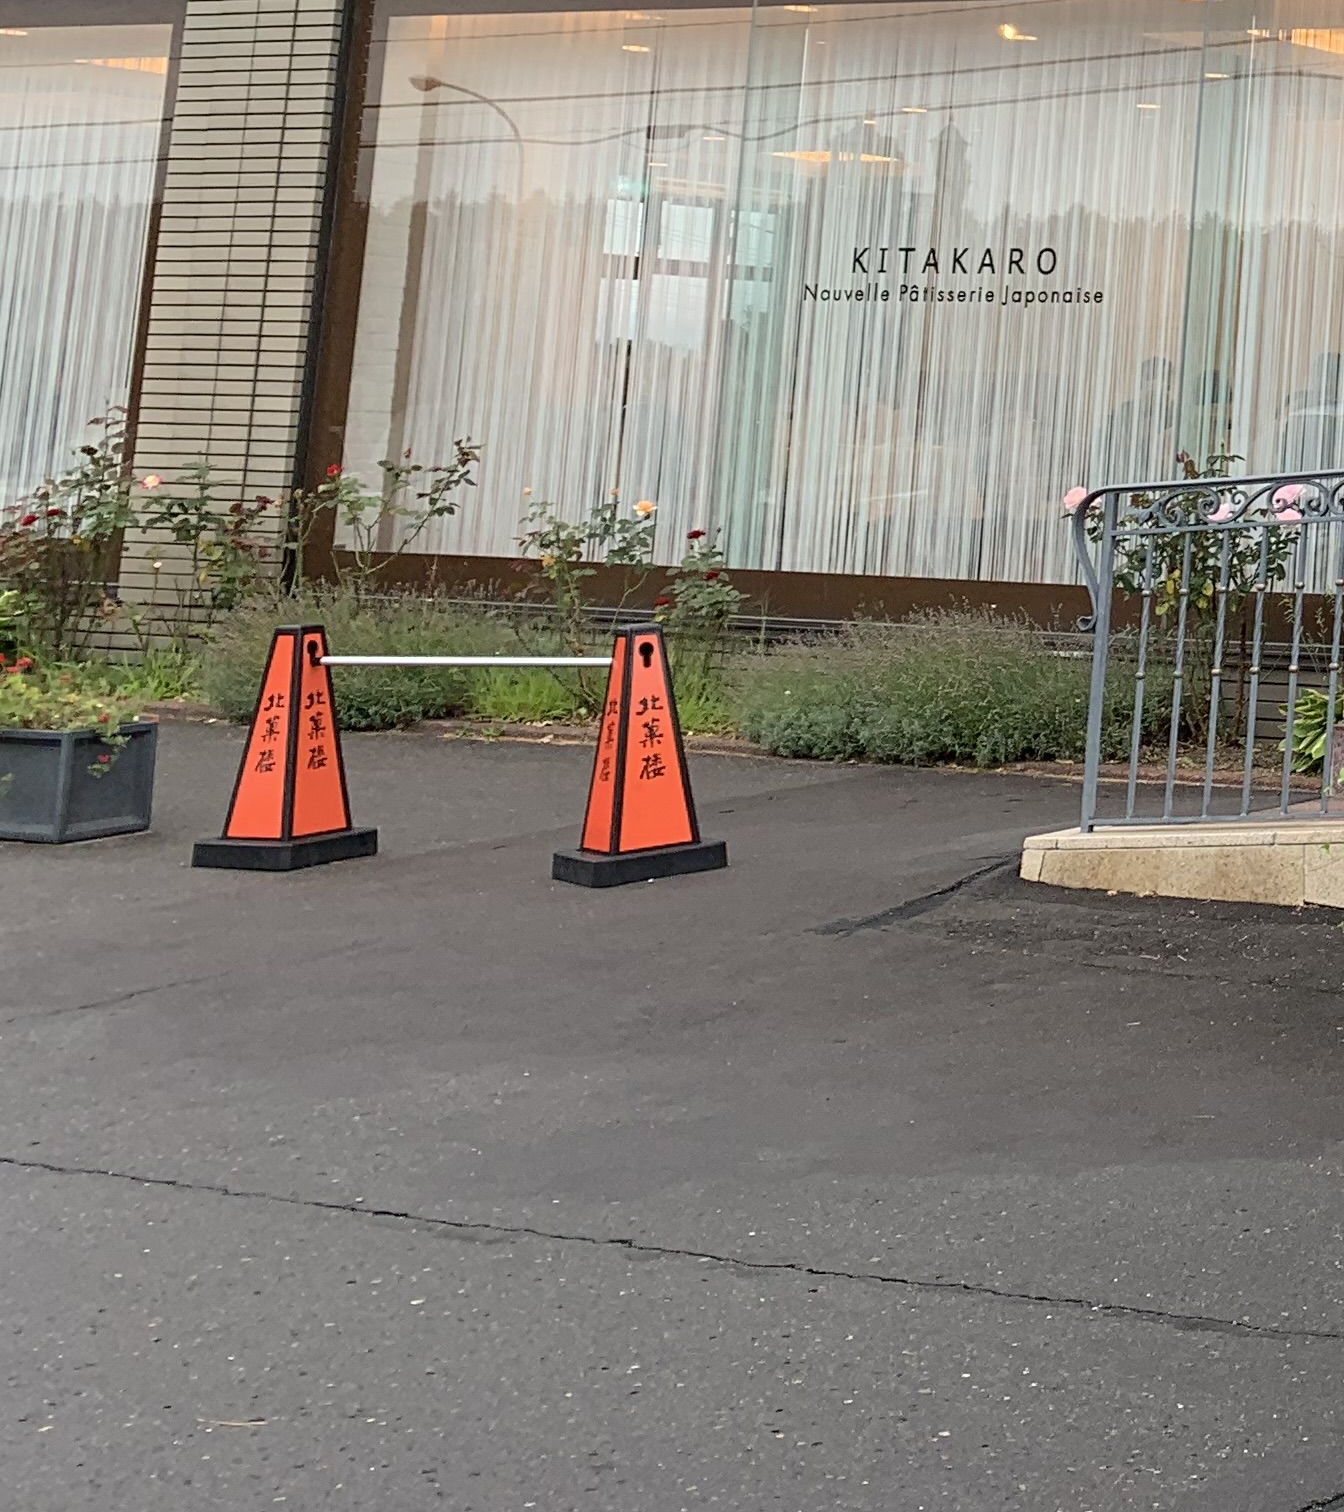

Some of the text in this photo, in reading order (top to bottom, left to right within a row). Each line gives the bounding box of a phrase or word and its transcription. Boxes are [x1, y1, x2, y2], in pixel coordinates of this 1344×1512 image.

[803, 283, 1104, 308] Nouvelle Pâtisserie Japonaise
[852, 247, 1057, 275] KITAKARO
[254, 693, 286, 774] 北菓楼
[304, 690, 328, 770] 北菓楼
[635, 694, 667, 781] 北菓楼
